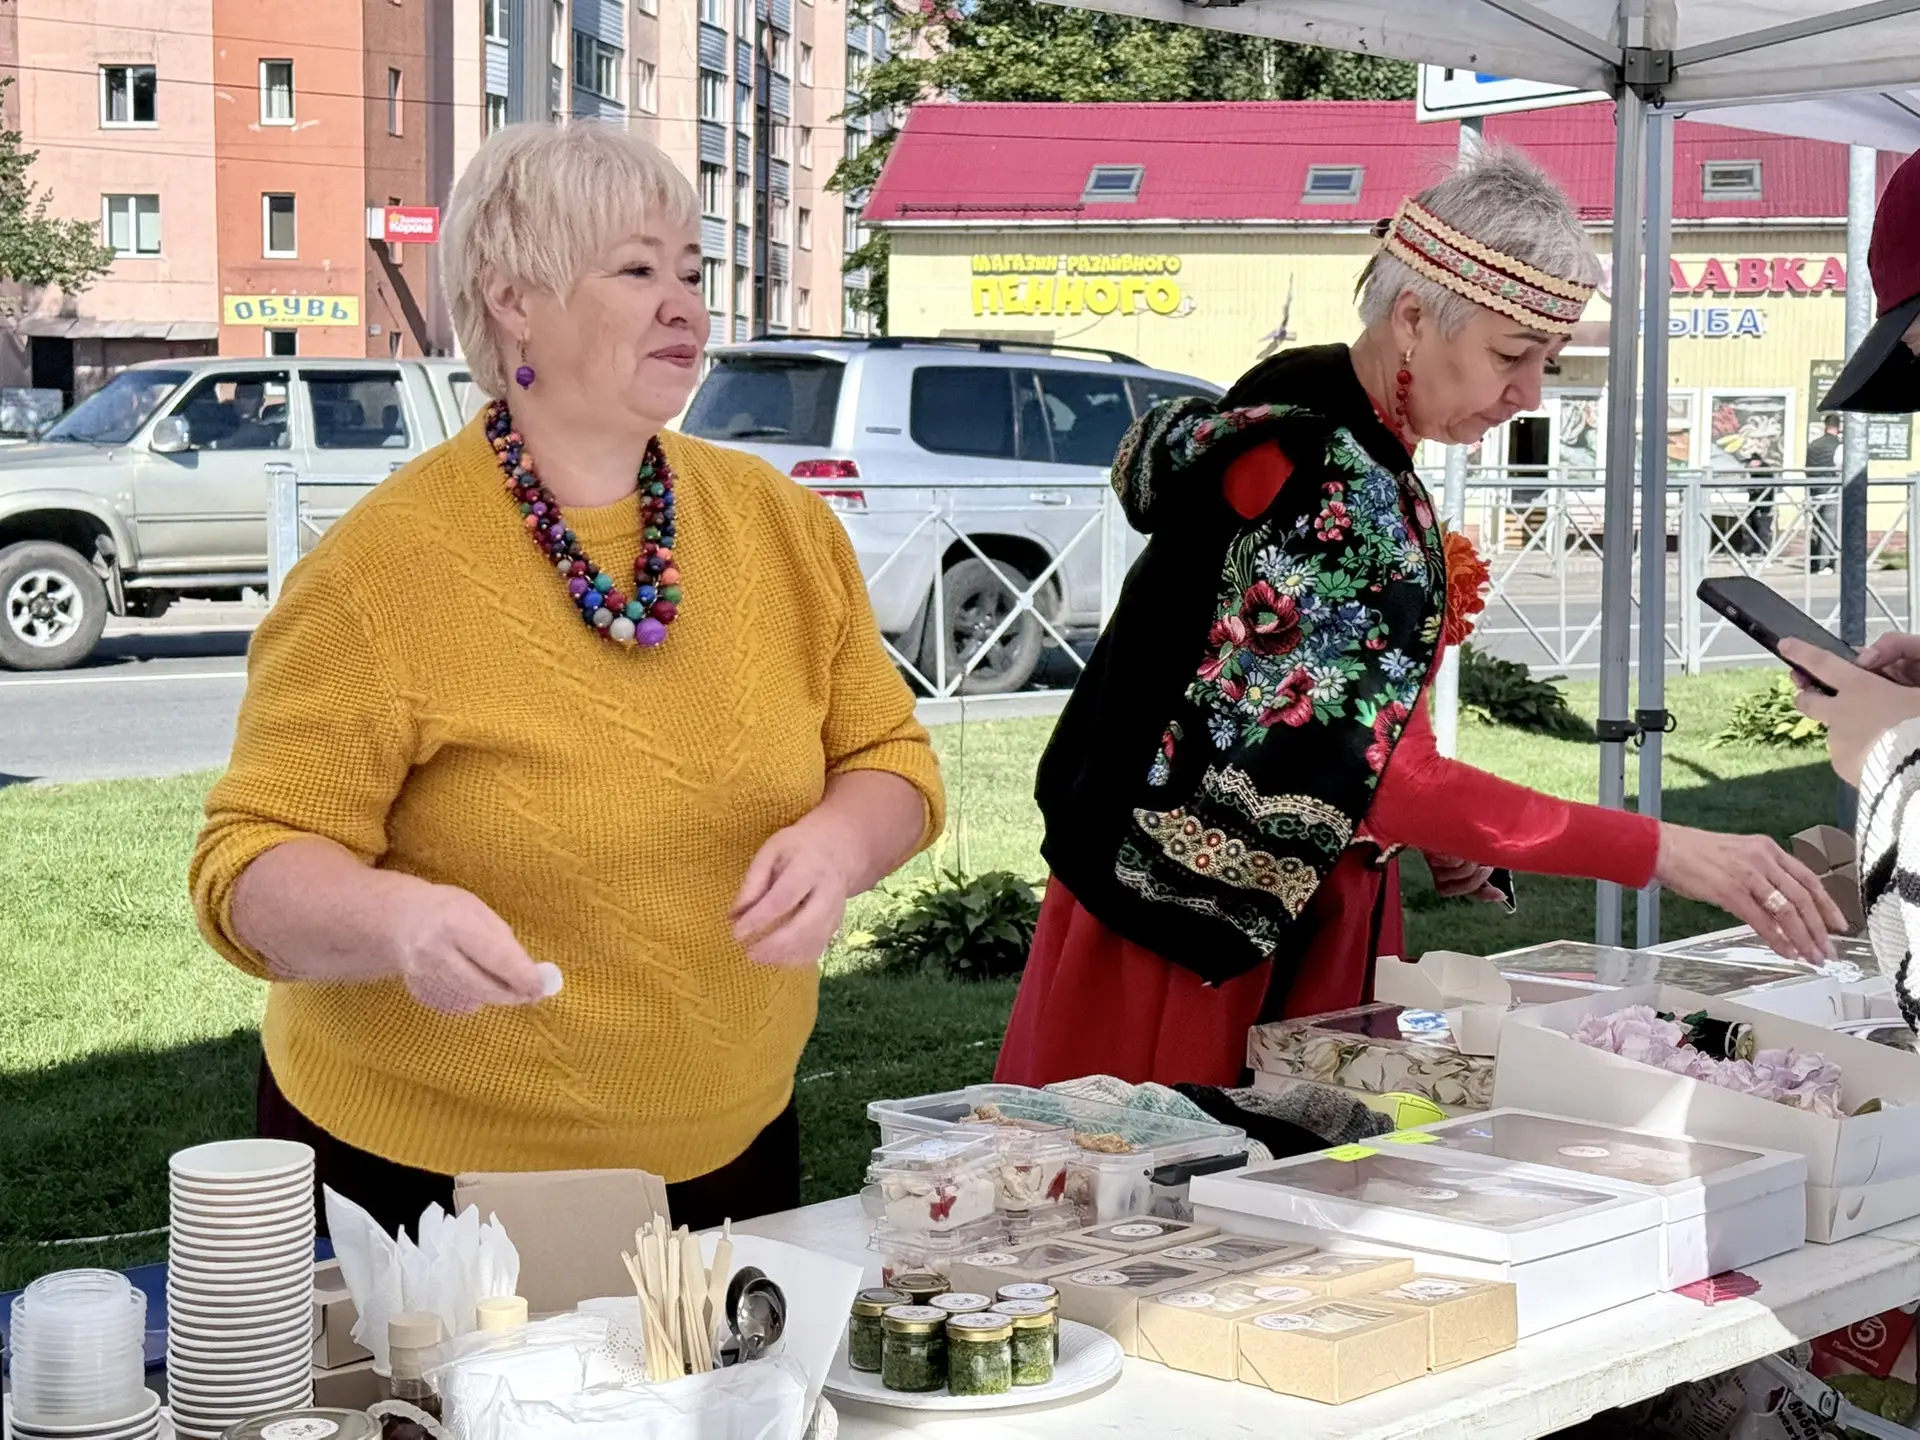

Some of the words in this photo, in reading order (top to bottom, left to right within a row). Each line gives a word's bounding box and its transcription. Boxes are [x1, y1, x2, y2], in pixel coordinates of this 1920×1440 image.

[972, 254, 1058, 275] МАГАЗИН
[1067, 253, 1182, 276] РАЗЛИВНОГО
[234, 297, 349, 320] ОБУВЬ
[972, 276, 1181, 316] ПЕННОГО
[1638, 307, 1767, 337] ЫБА
